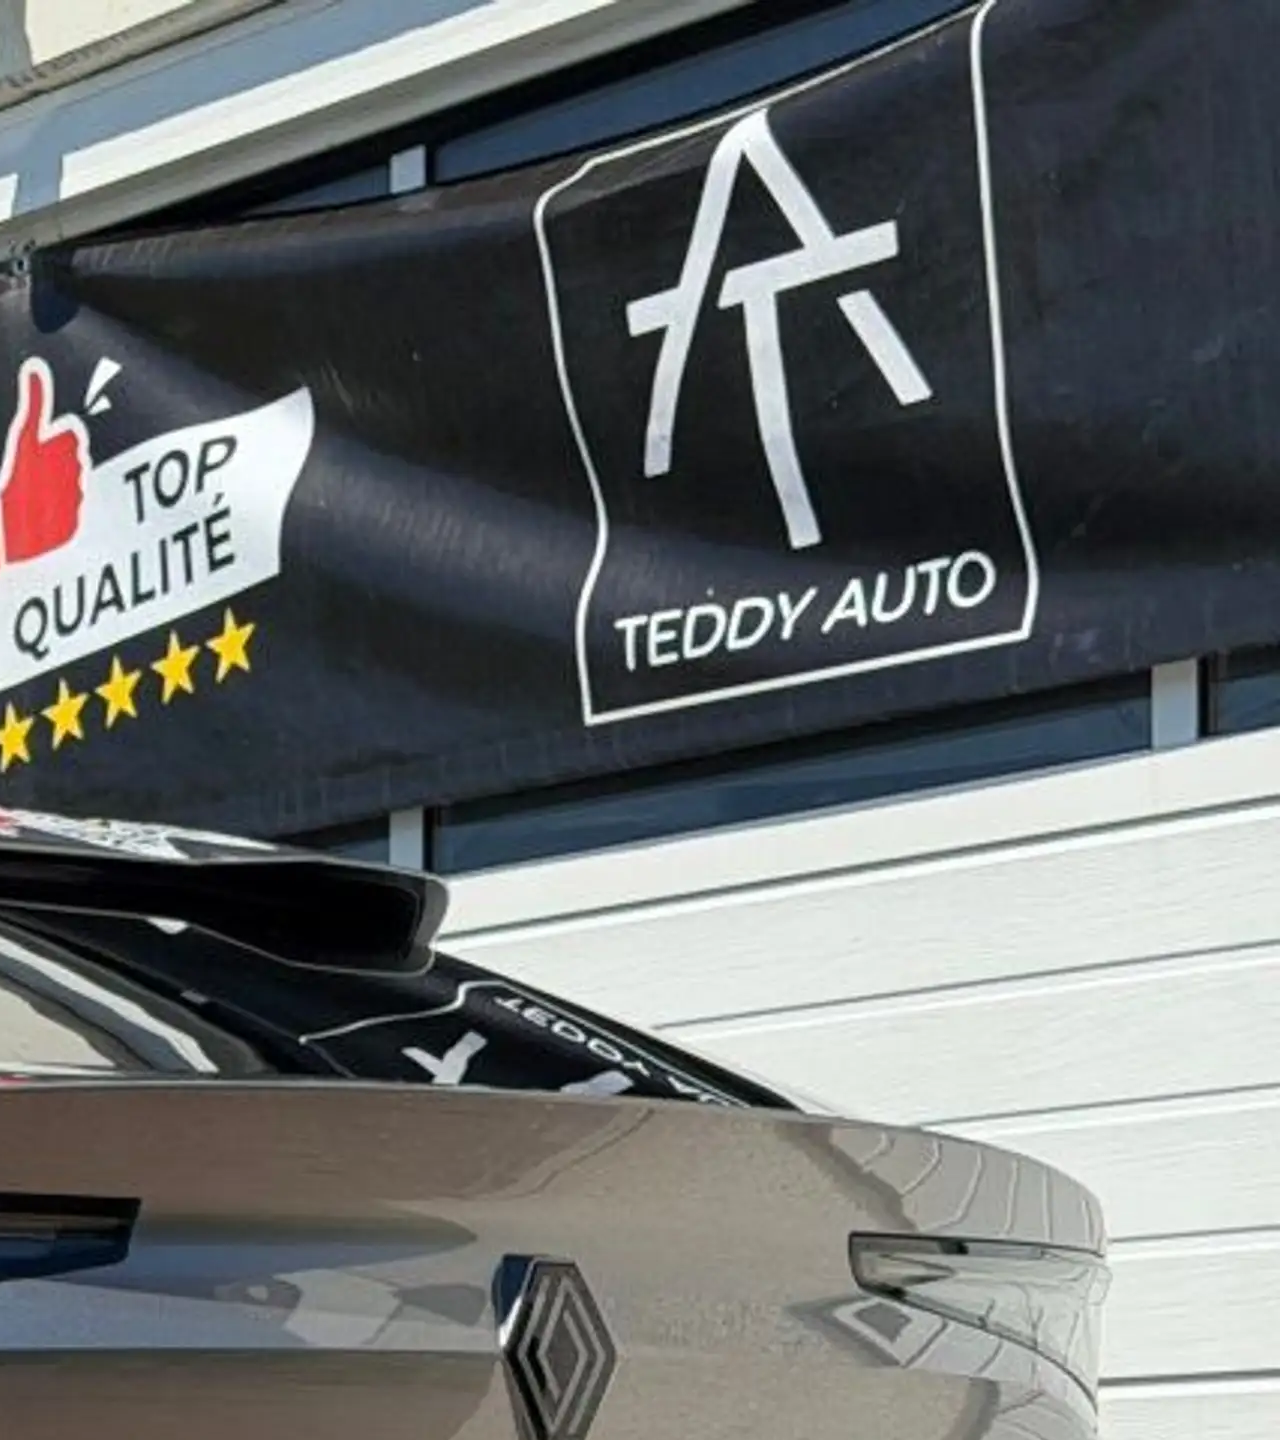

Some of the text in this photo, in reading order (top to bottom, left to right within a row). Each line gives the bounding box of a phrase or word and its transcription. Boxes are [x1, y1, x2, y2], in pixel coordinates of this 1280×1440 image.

[123, 434, 238, 524] TOP
[12, 492, 236, 661] QUALITÉ
[614, 550, 997, 671] TEDDY AUTO
